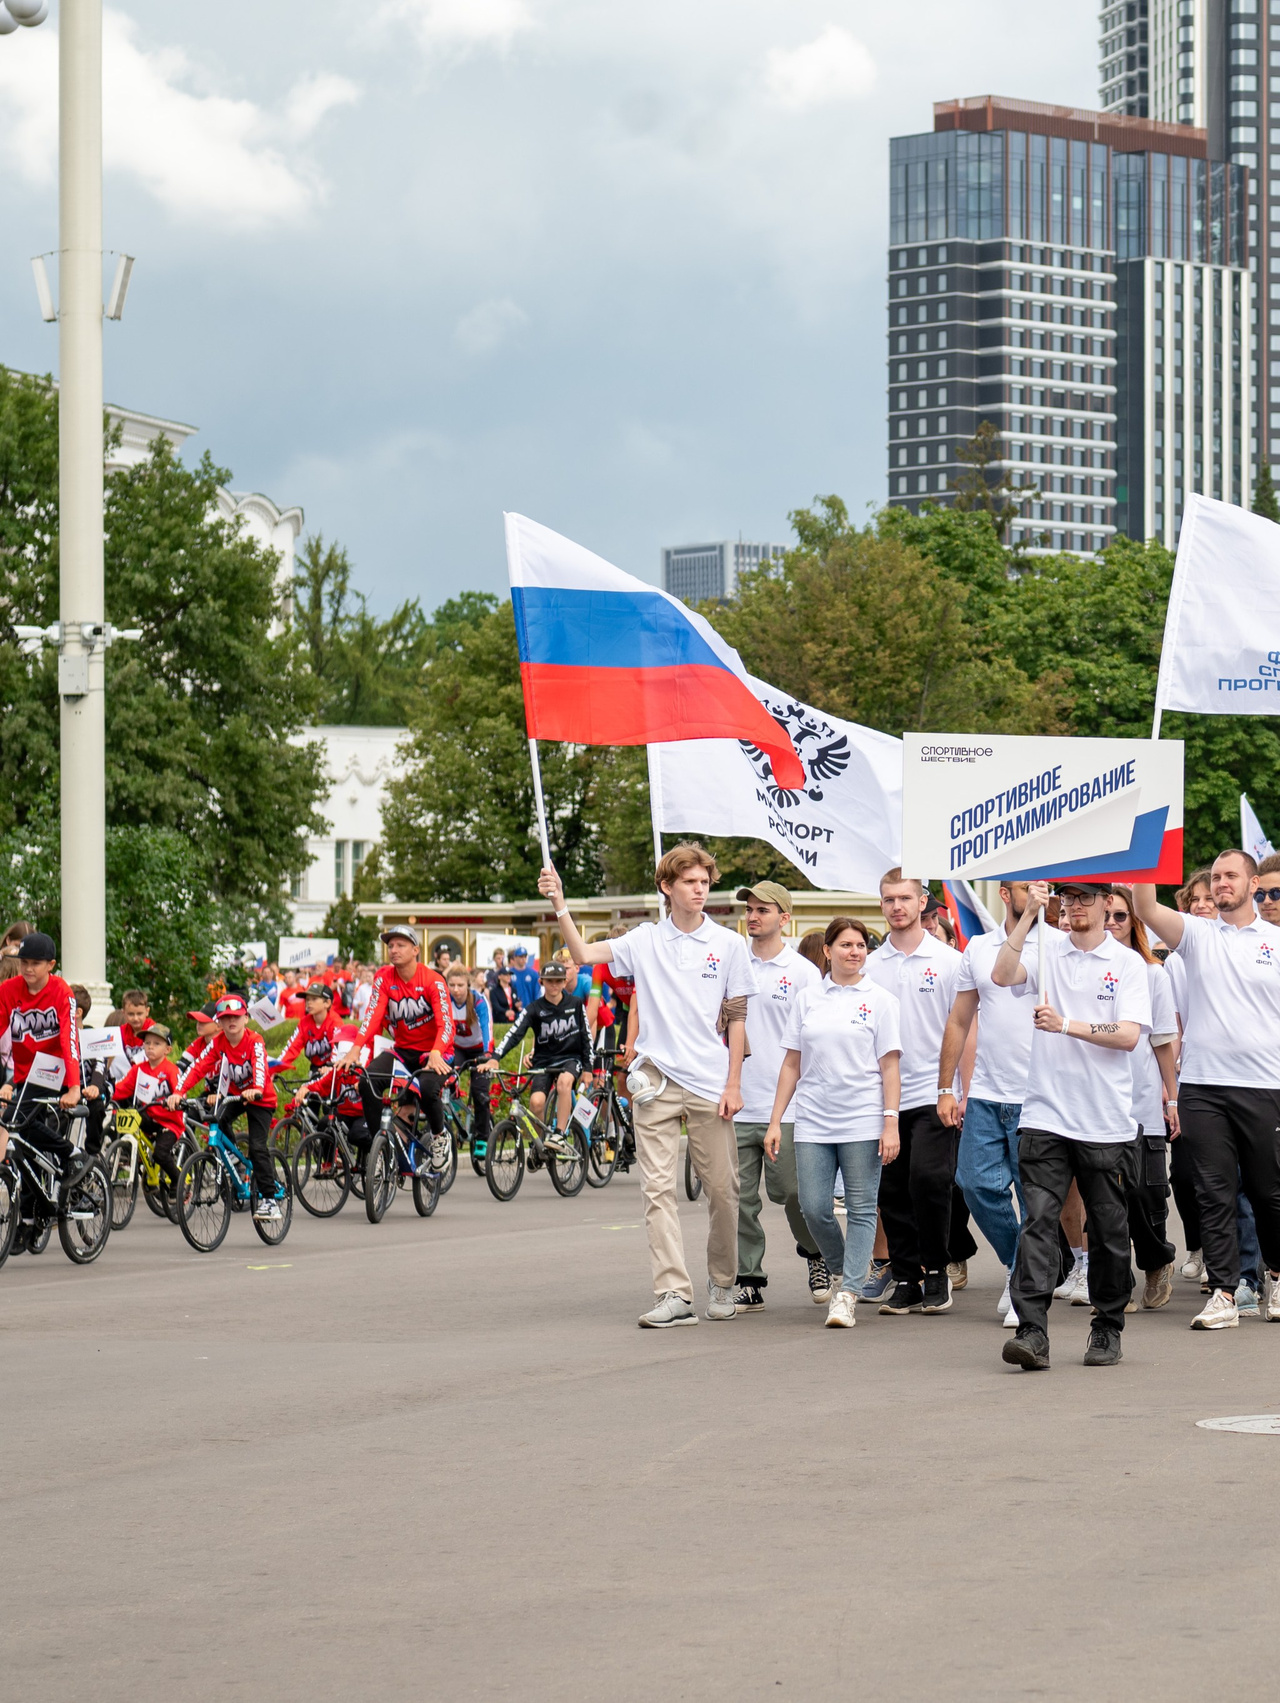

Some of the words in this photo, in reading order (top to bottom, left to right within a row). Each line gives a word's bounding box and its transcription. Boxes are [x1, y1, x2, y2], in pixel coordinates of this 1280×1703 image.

[950, 765, 1062, 840] СПОРТИВНОЕ
[950, 758, 1136, 871] ПРОГРАММИРОВАНИЕ
[289, 948, 311, 965] ЛАПТА
[117, 1115, 135, 1128] 107
